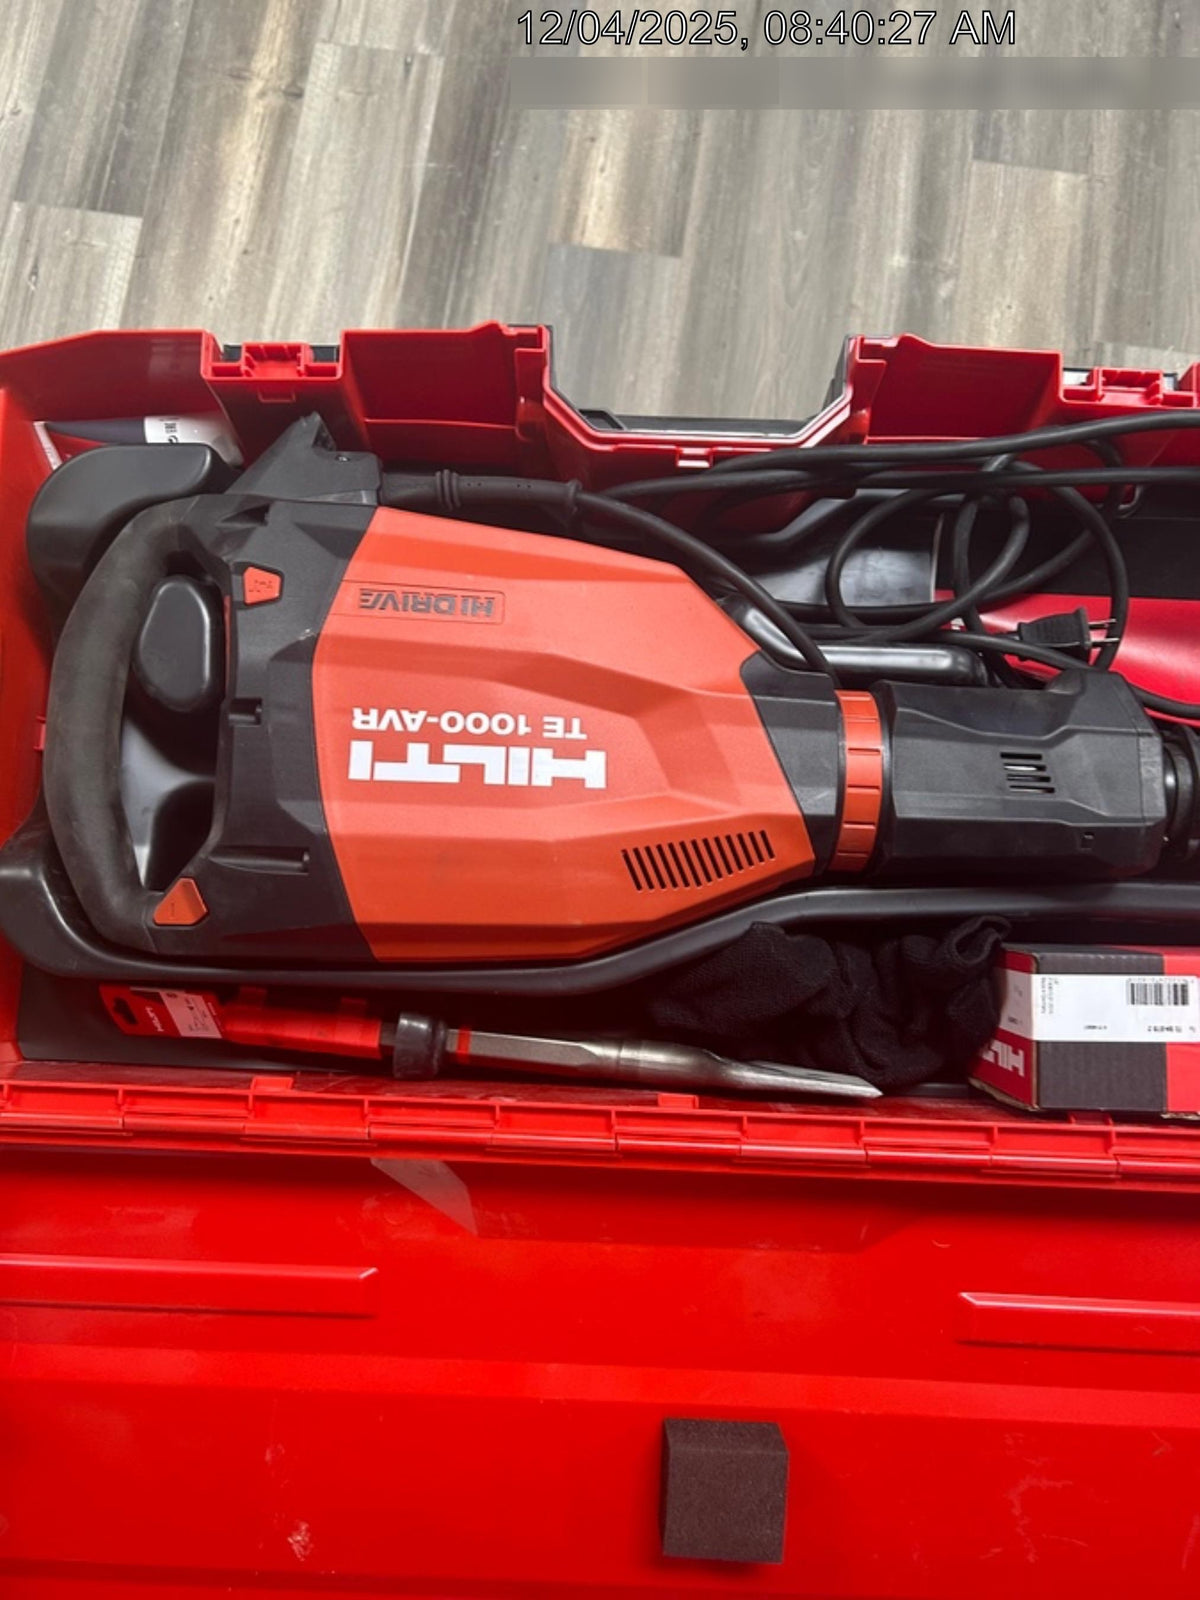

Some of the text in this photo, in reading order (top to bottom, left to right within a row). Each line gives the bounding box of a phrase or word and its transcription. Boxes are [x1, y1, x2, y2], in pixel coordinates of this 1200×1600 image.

[359, 589, 495, 618] HI DRIVE
[352, 708, 587, 740] TE 1000-AVR
[348, 741, 606, 789] HILTI
[981, 1040, 1025, 1077] HILT
